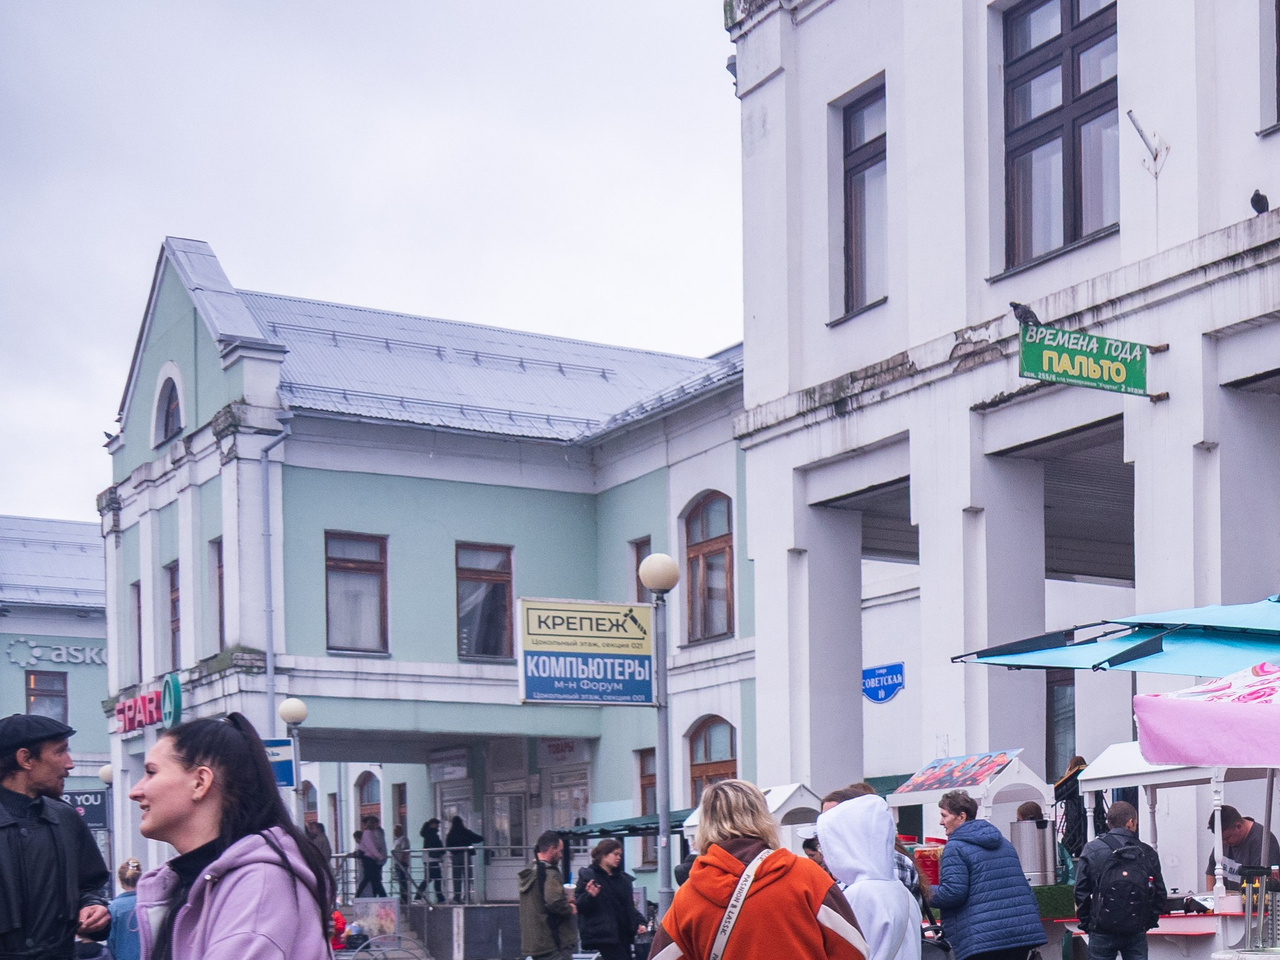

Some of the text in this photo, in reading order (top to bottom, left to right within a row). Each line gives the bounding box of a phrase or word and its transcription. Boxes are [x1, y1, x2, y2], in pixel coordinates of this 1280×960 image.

[1026, 326, 1143, 363] ВРЕМЕНА ГОДА
[1042, 349, 1127, 384] ПАЛЬТО
[537, 614, 628, 633] КРЕПЕЖ
[527, 655, 650, 680] КОМПЬЮТЕРЫ
[580, 680, 623, 693] Форум
[115, 691, 162, 733] SPAR
[74, 794, 102, 806] YOU
